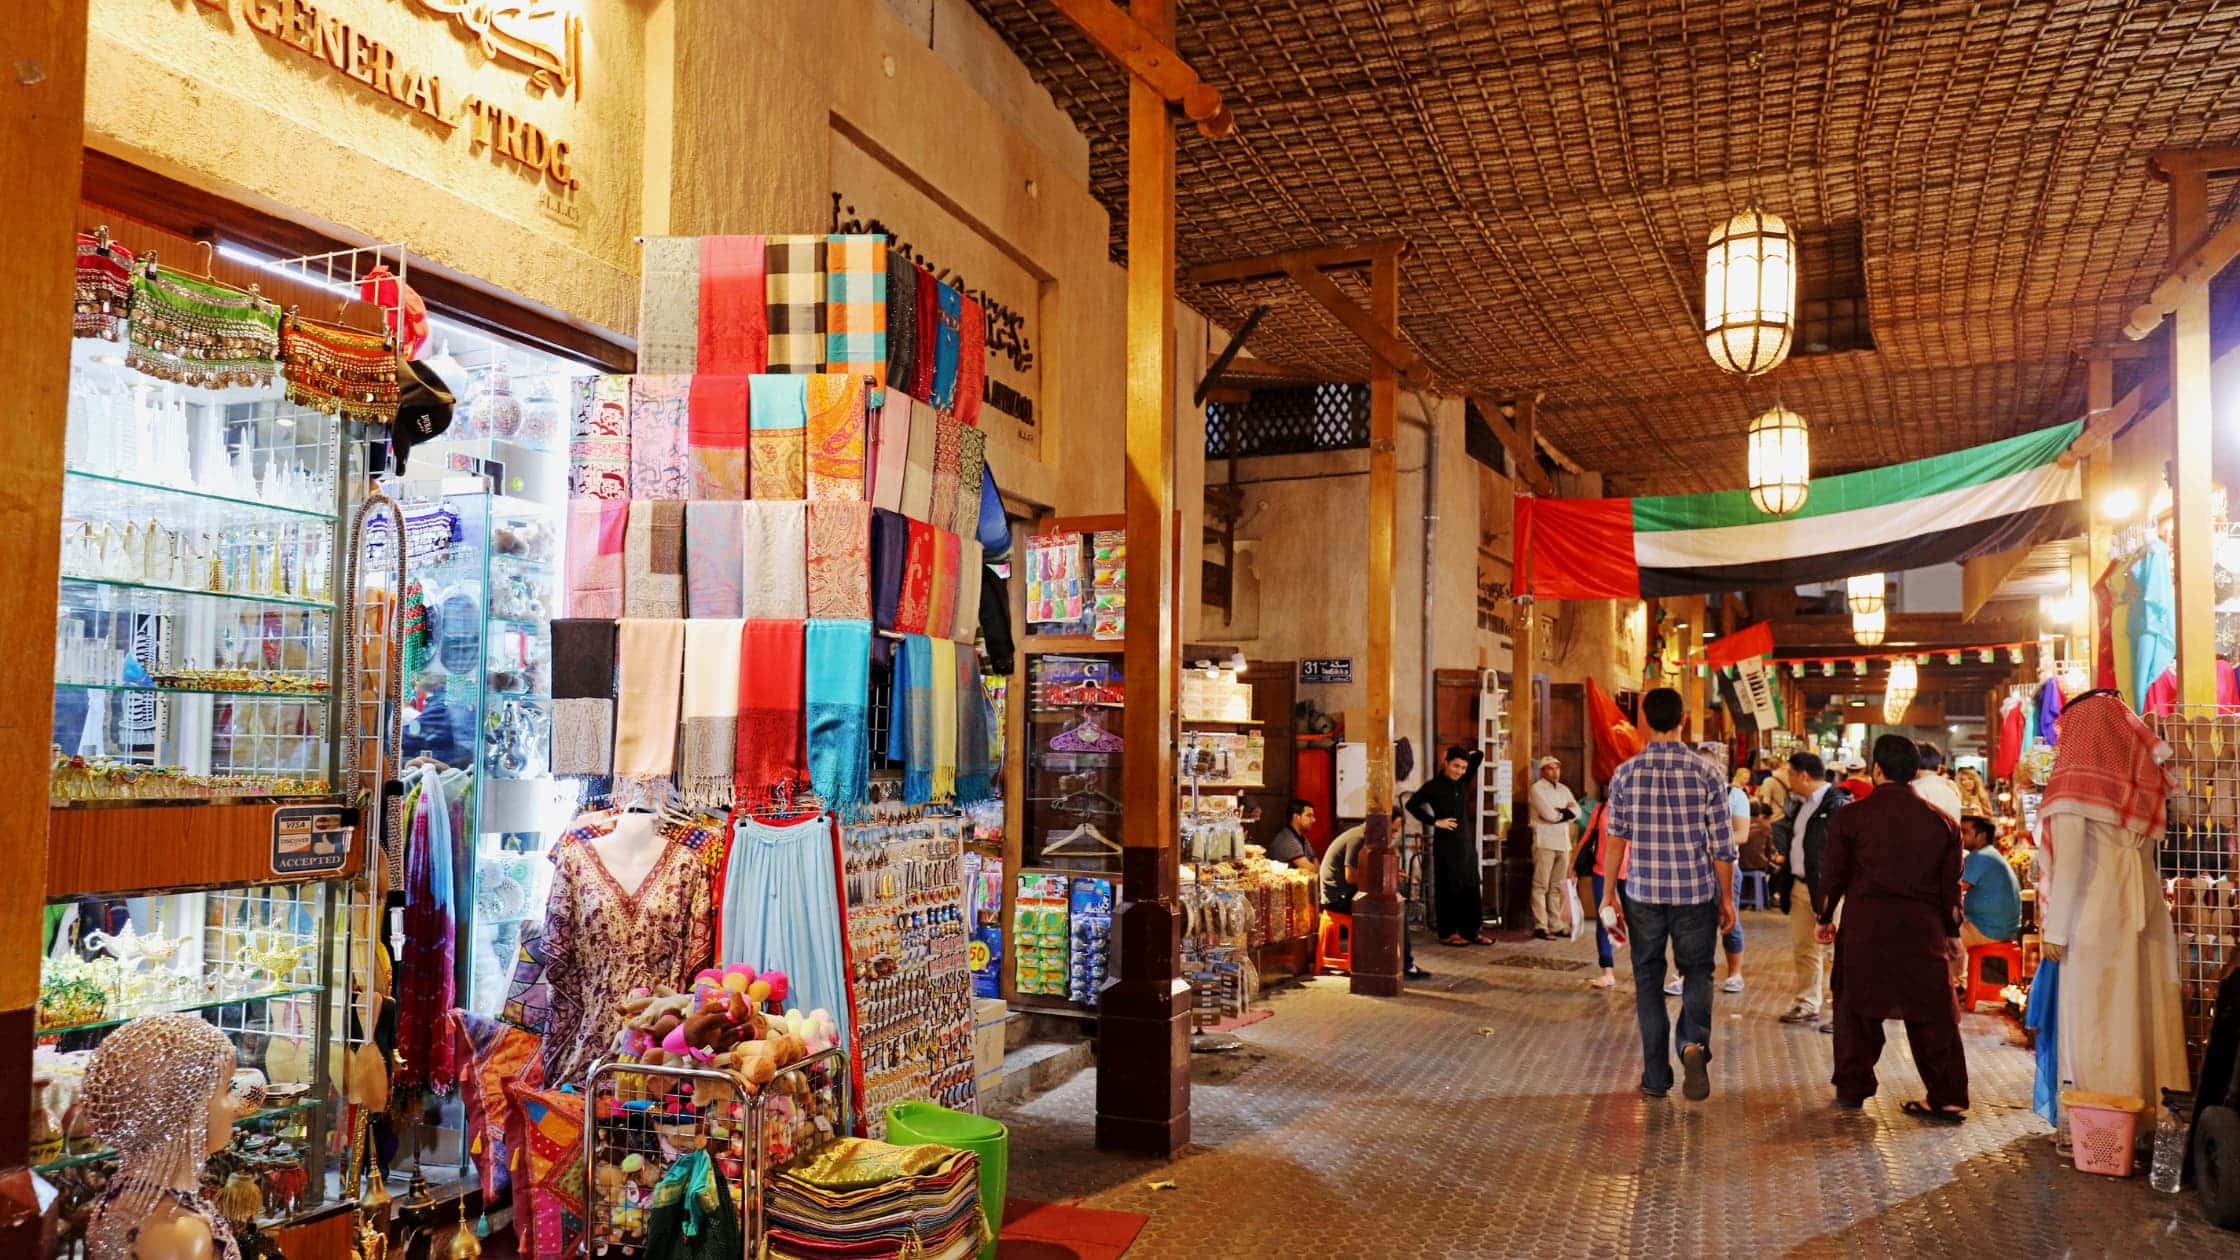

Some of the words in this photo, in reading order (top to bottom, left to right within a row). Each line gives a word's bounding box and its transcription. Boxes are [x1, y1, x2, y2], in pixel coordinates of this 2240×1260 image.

[242, 0, 459, 129] GENERAL
[465, 94, 580, 191] TRDG.
[1304, 661, 1318, 675] 31
[286, 821, 306, 829] VISA
[279, 856, 341, 868] ACCEPTED
